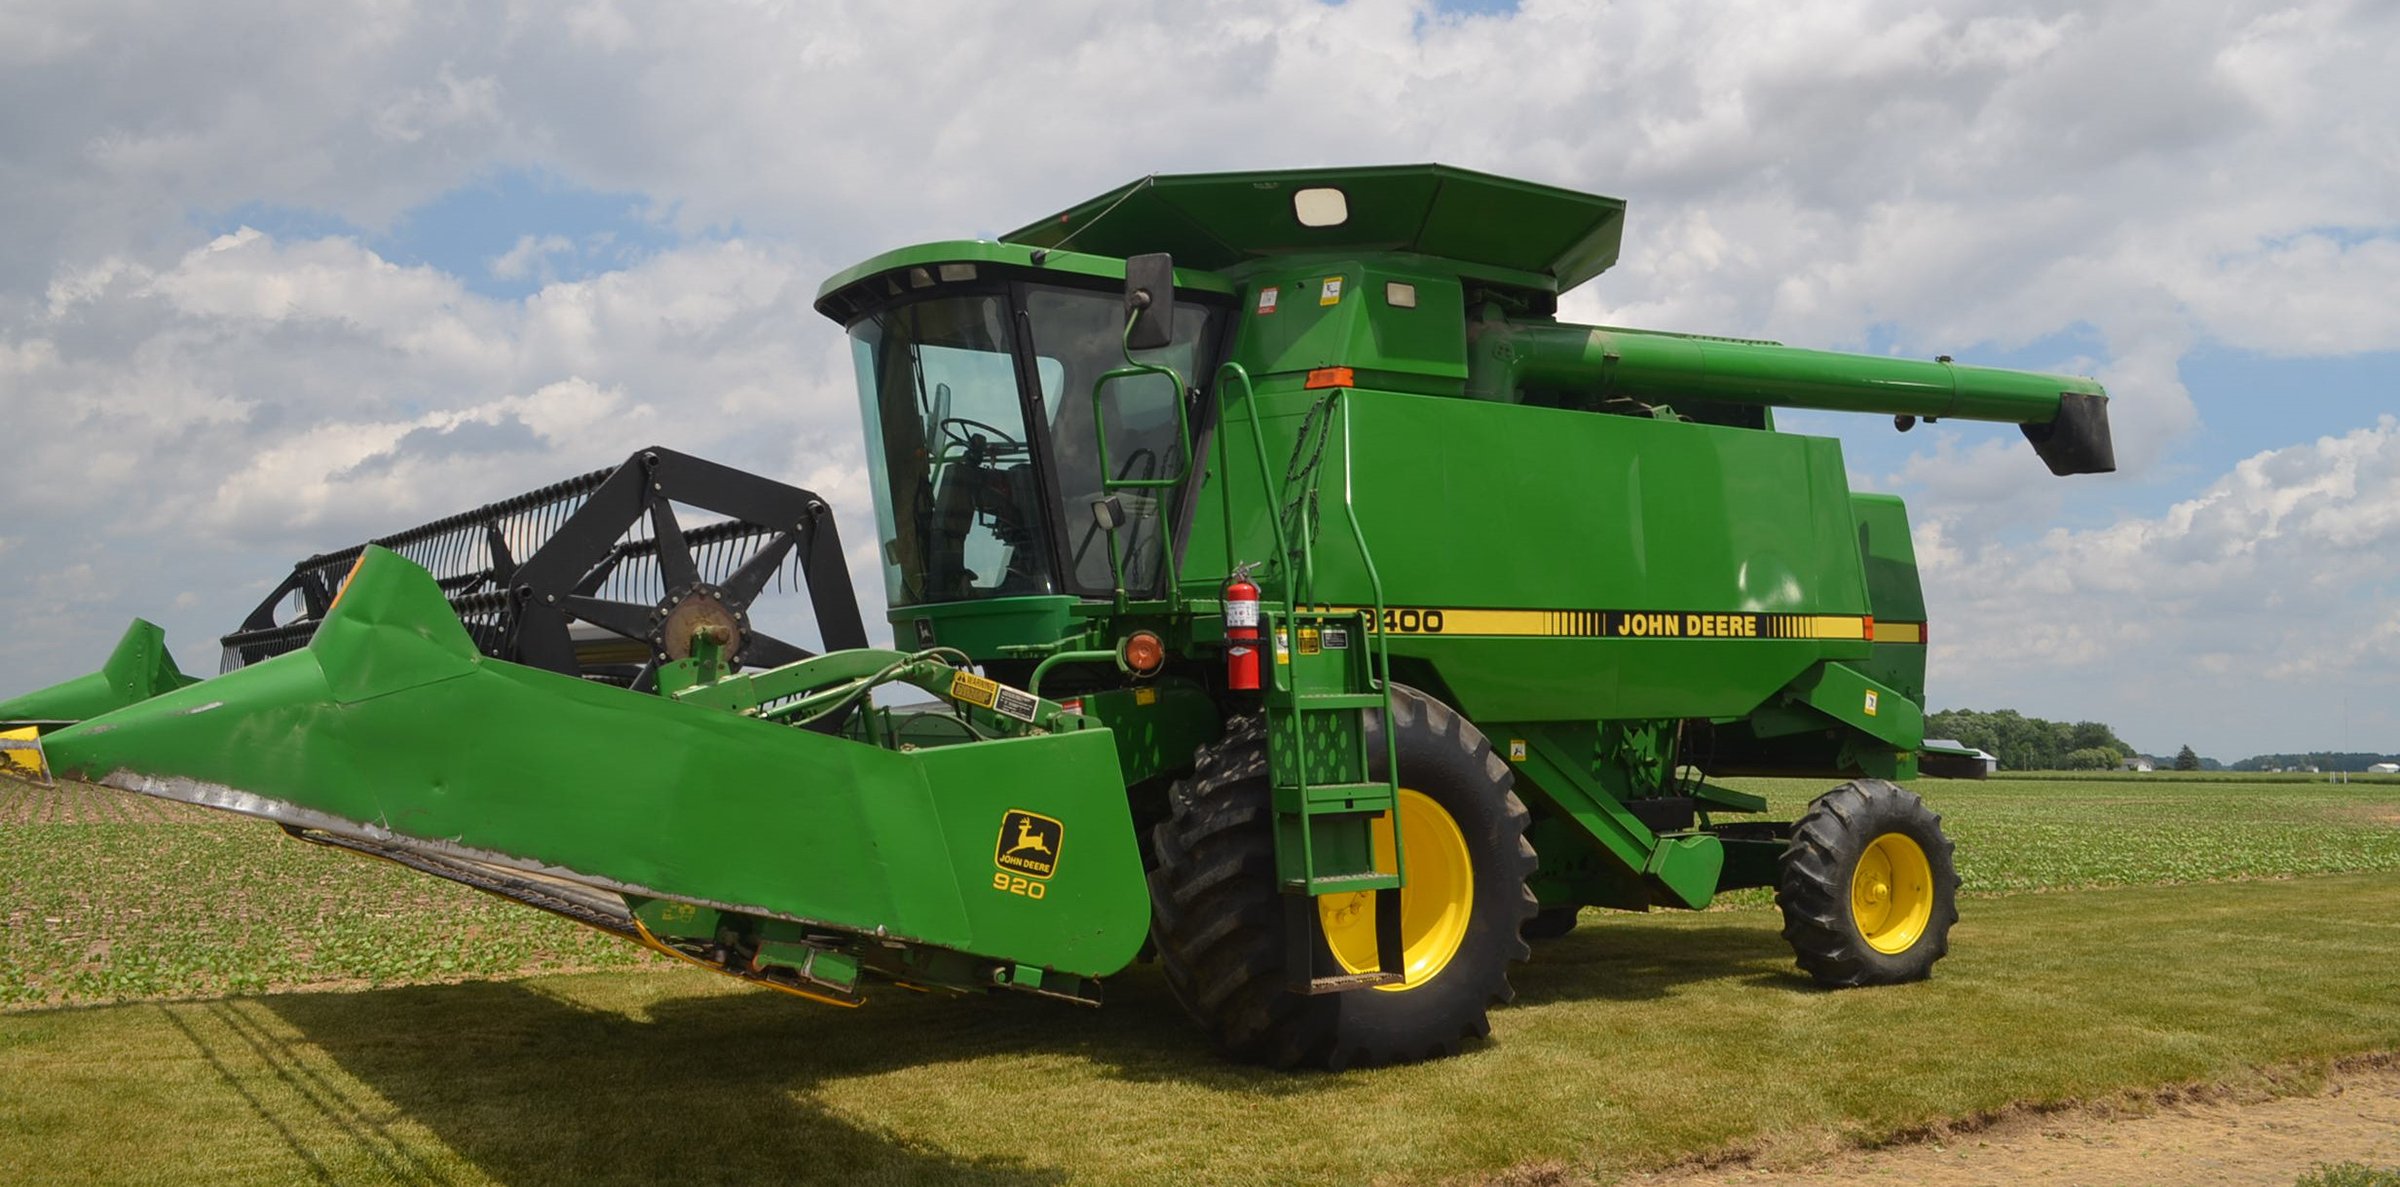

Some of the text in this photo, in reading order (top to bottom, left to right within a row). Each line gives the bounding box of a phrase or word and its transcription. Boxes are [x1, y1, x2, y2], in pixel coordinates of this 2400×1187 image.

[1618, 613, 1757, 637] JOHN DEERE
[966, 675, 996, 692] WARNING
[999, 854, 1051, 873] JOHN DEERE
[993, 872, 1045, 899] 920
